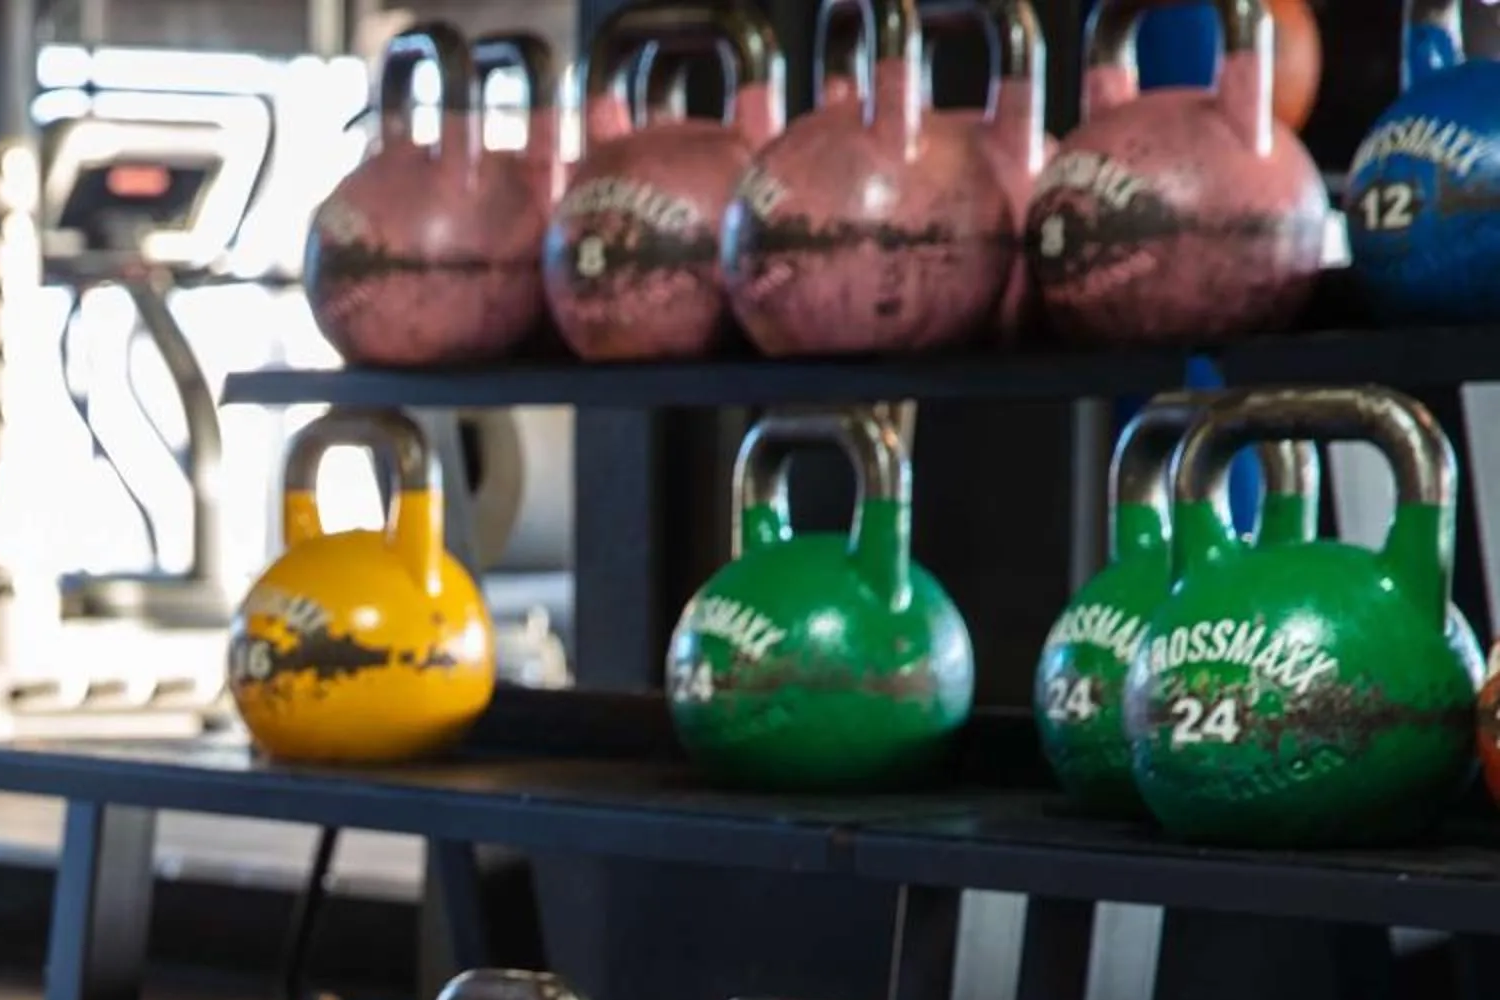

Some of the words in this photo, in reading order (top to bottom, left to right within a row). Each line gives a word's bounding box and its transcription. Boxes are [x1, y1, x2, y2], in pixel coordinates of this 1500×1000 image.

[1362, 183, 1413, 231] 12
[1047, 677, 1092, 720] 24
[1171, 697, 1241, 746] 24
